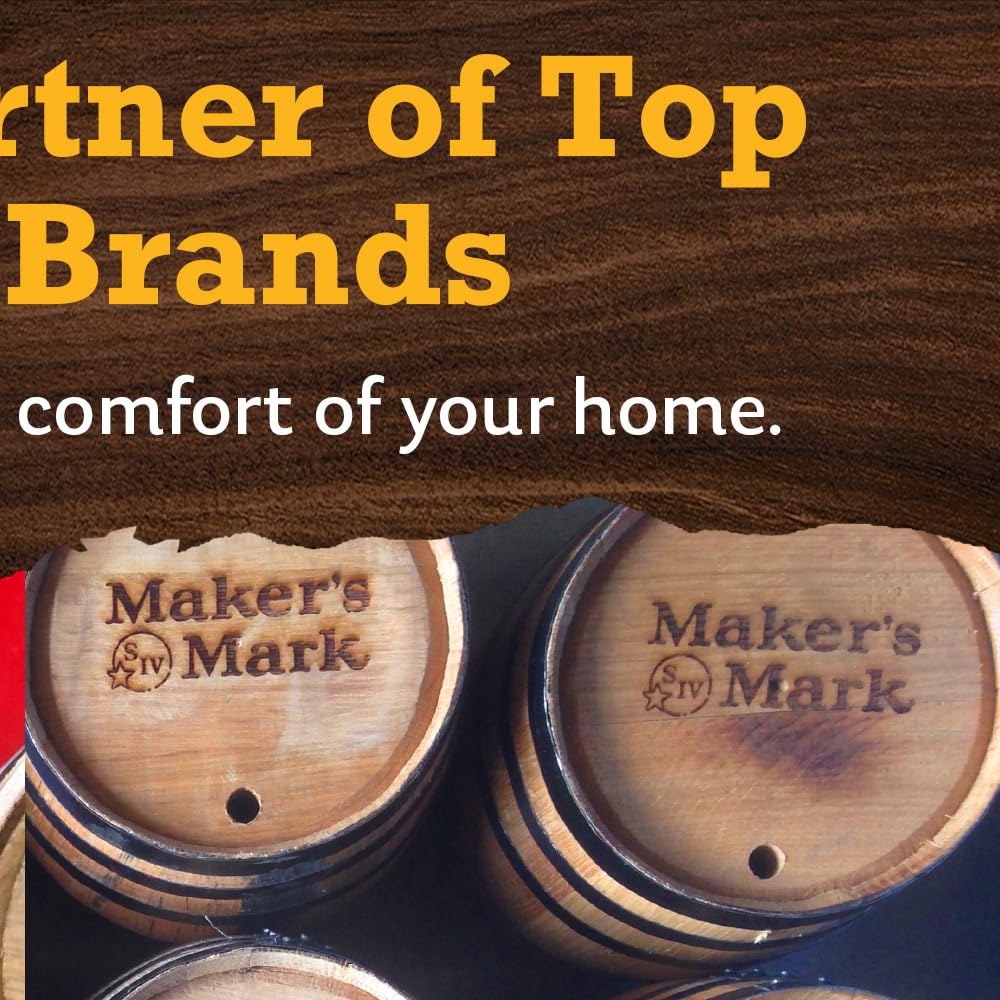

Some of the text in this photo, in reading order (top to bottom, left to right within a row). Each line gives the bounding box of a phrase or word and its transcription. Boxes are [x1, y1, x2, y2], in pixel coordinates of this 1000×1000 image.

[105, 571, 373, 625] Maker's
[181, 628, 372, 680] Mark
[648, 600, 922, 656] Maker's
[719, 662, 914, 714] Mark
